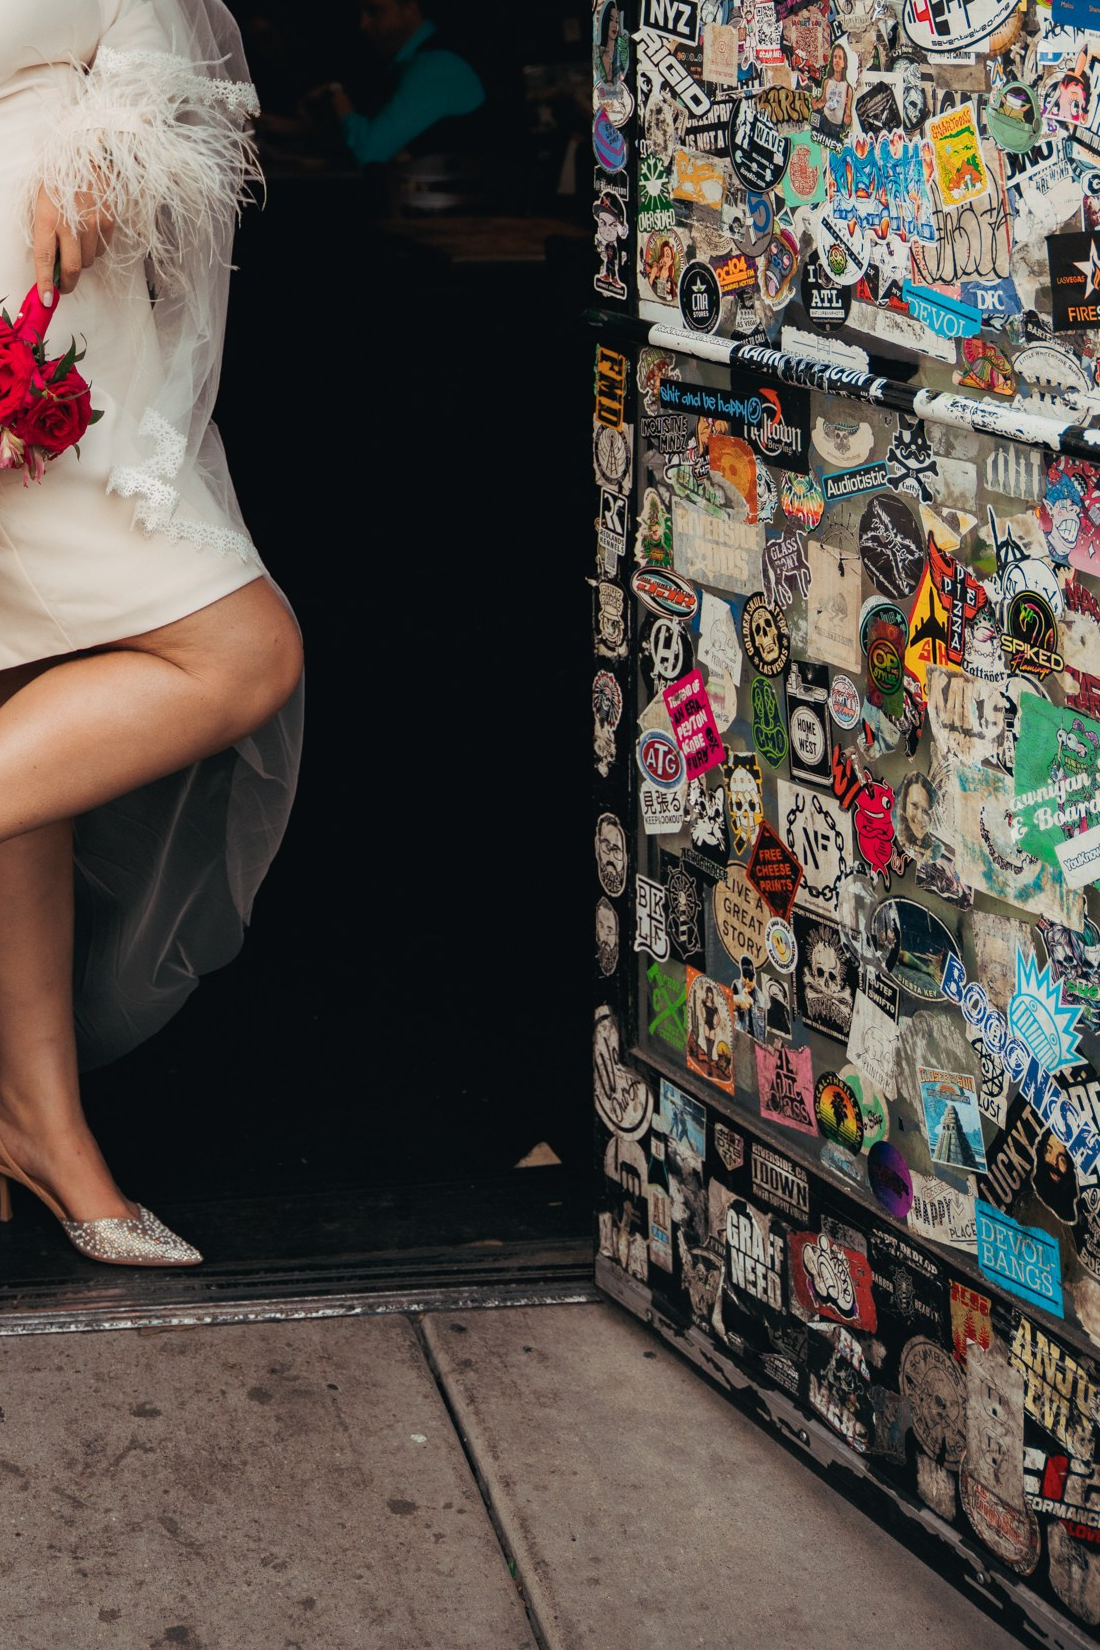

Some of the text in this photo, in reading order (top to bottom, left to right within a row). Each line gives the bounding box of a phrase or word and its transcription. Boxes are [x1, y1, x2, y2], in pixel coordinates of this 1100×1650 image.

[755, 122, 785, 153] WAVE
[812, 291, 842, 308] ATL
[681, 390, 701, 407] and
[827, 467, 887, 497] Audiotistic
[1002, 633, 1063, 670] SPIKED
[797, 720, 815, 733] HOME
[799, 740, 817, 754] WEST
[646, 751, 677, 778] ATG
[759, 849, 782, 861] FREE
[756, 862, 791, 876] CHEESE
[760, 877, 793, 890] PRINTS
[723, 901, 764, 930] GREAT
[722, 922, 762, 958] STORY
[980, 1246, 1053, 1297] BANGS
